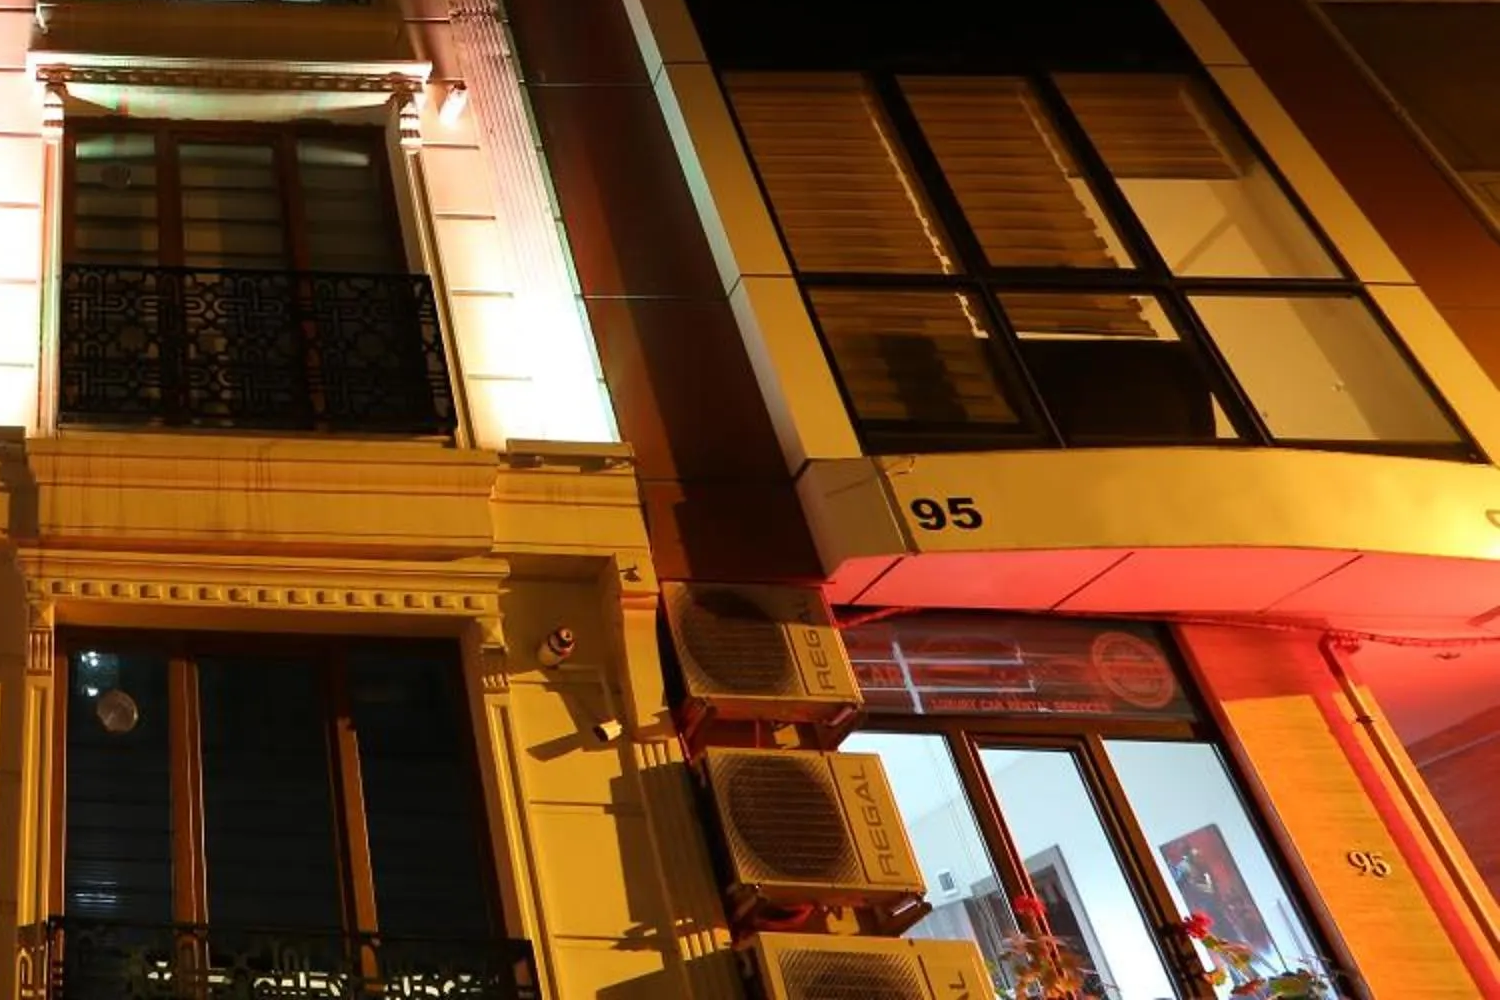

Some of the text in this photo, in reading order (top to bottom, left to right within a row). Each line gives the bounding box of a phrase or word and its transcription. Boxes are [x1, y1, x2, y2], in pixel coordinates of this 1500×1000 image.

[911, 497, 982, 530] 95
[849, 763, 901, 876] REGAL
[1346, 850, 1391, 880] 95
